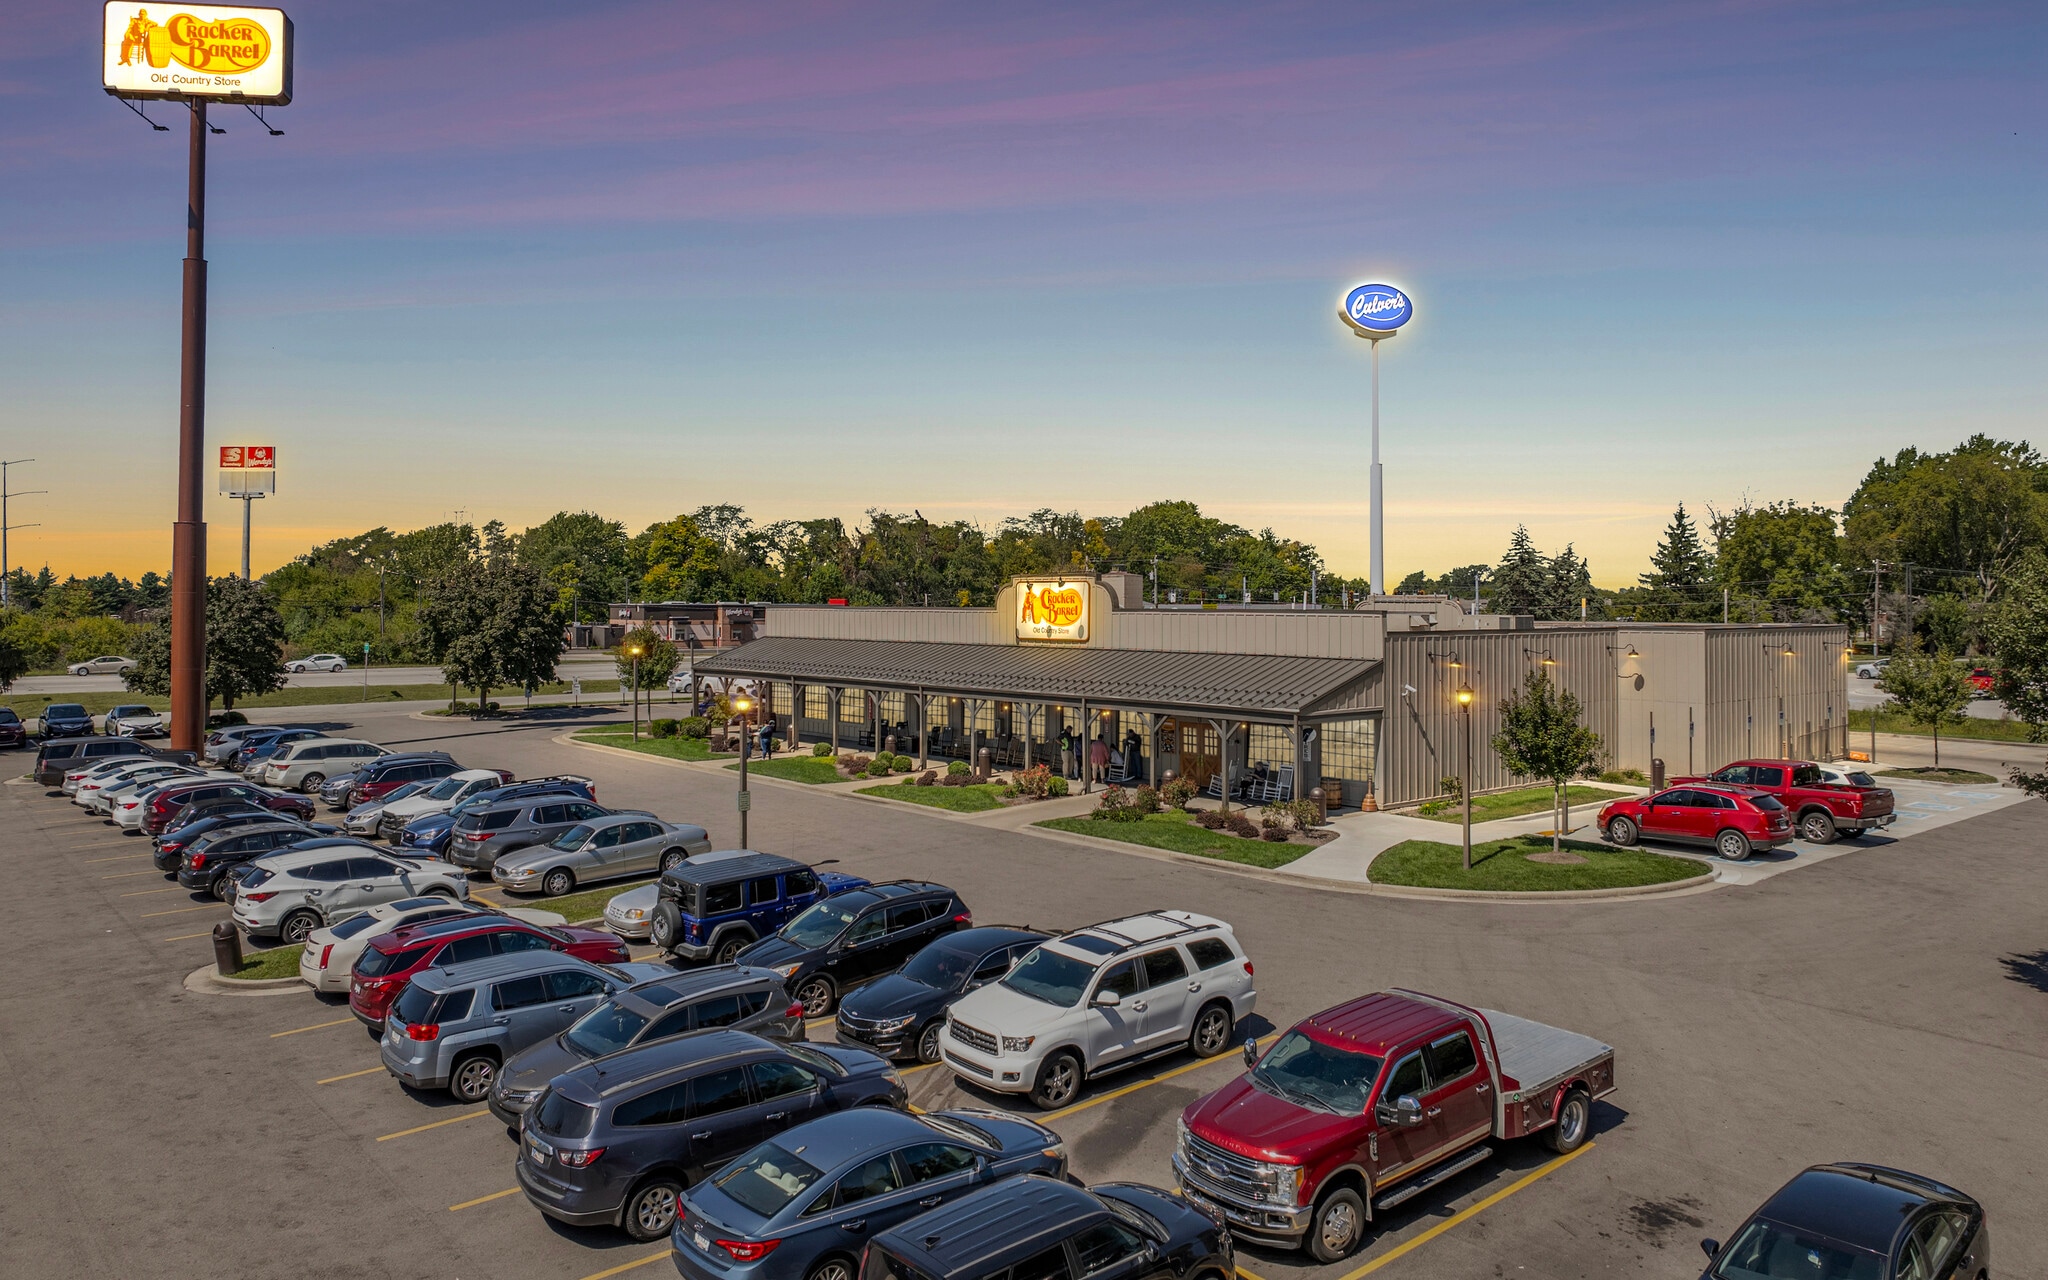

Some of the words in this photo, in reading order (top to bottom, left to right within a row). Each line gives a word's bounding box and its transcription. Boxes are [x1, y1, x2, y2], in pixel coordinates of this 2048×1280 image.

[168, 15, 253, 47] Cracker
[189, 37, 260, 68] Barrel
[151, 73, 169, 83] Old
[172, 74, 211, 87] Country
[214, 76, 241, 87] Store
[1351, 292, 1406, 319] Culver's
[1040, 590, 1075, 609] Cracker
[1048, 604, 1078, 623] Barrel
